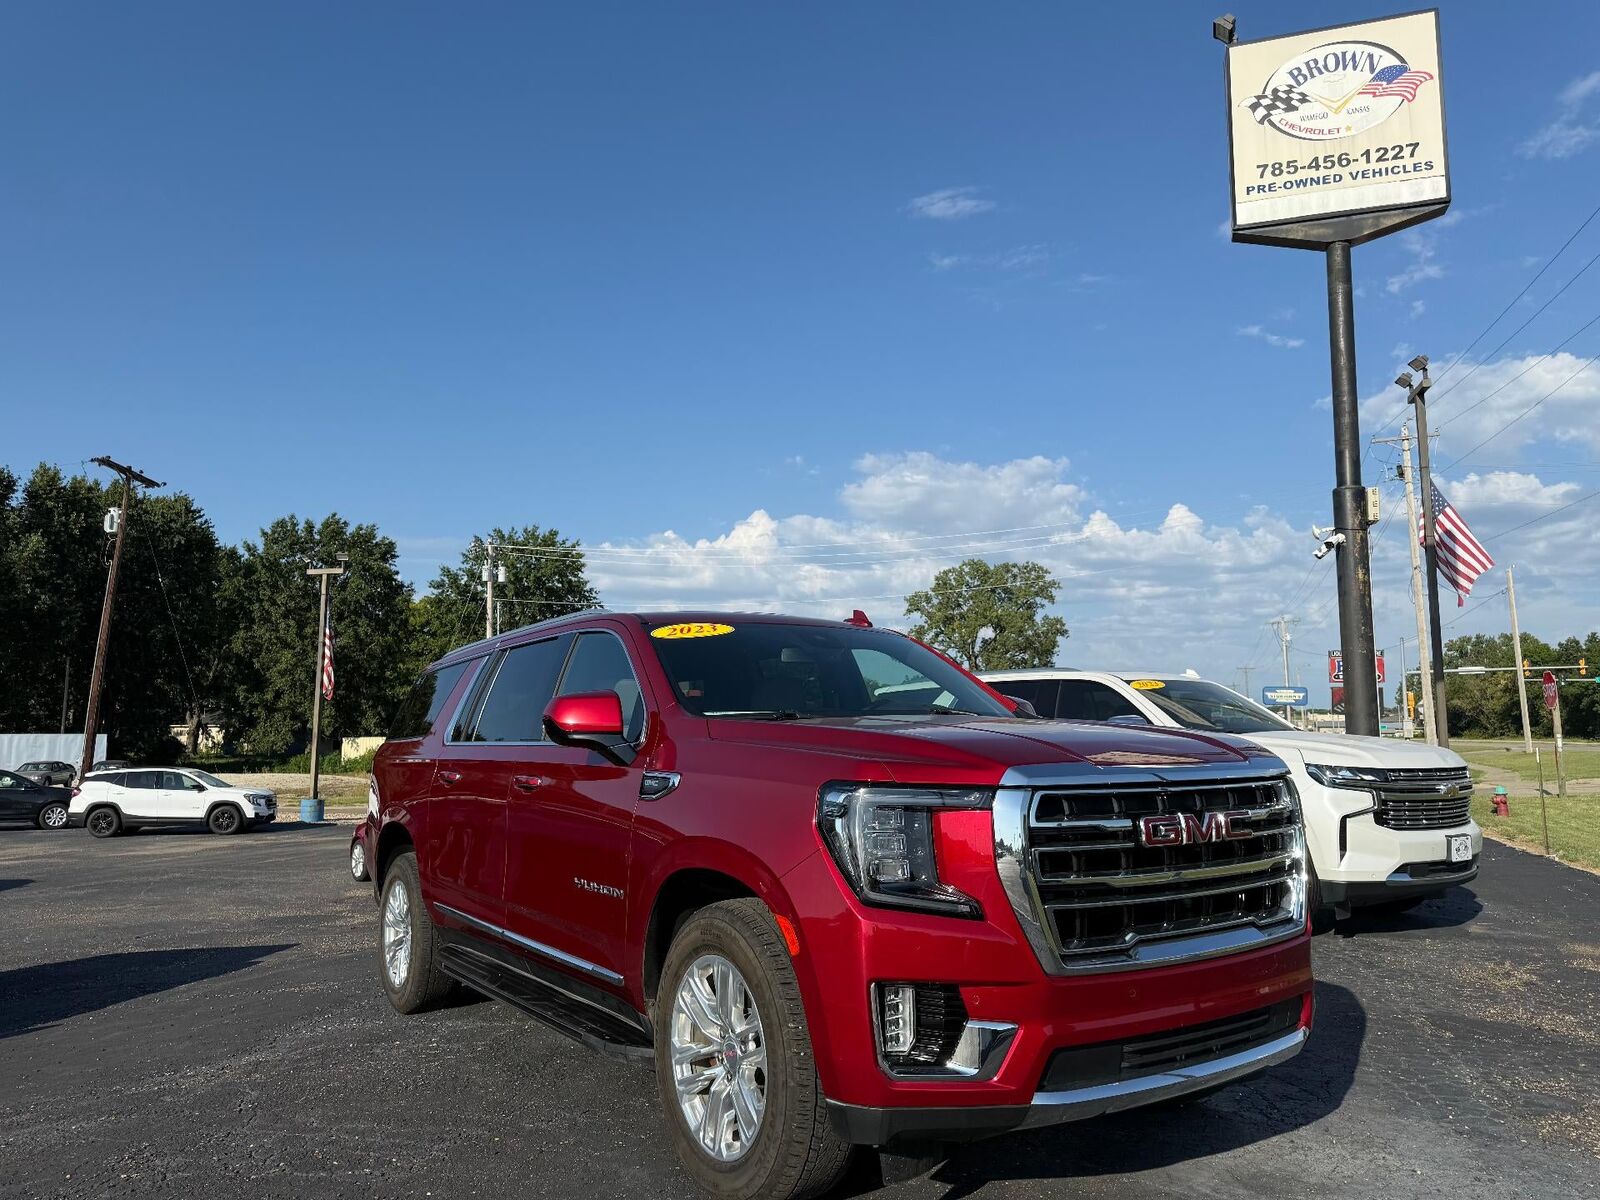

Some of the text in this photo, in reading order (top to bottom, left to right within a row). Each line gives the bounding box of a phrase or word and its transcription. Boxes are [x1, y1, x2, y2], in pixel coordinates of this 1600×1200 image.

[1286, 50, 1382, 87] BROWN
[1279, 118, 1342, 135] CHEVROLET
[1300, 105, 1370, 122] WAMEGO KANSAS
[1246, 160, 1434, 195] PRE-OWNED VEHICLES
[1256, 142, 1420, 179] 785-456-1227
[667, 625, 718, 636] 2023
[1140, 810, 1254, 847] GMC
